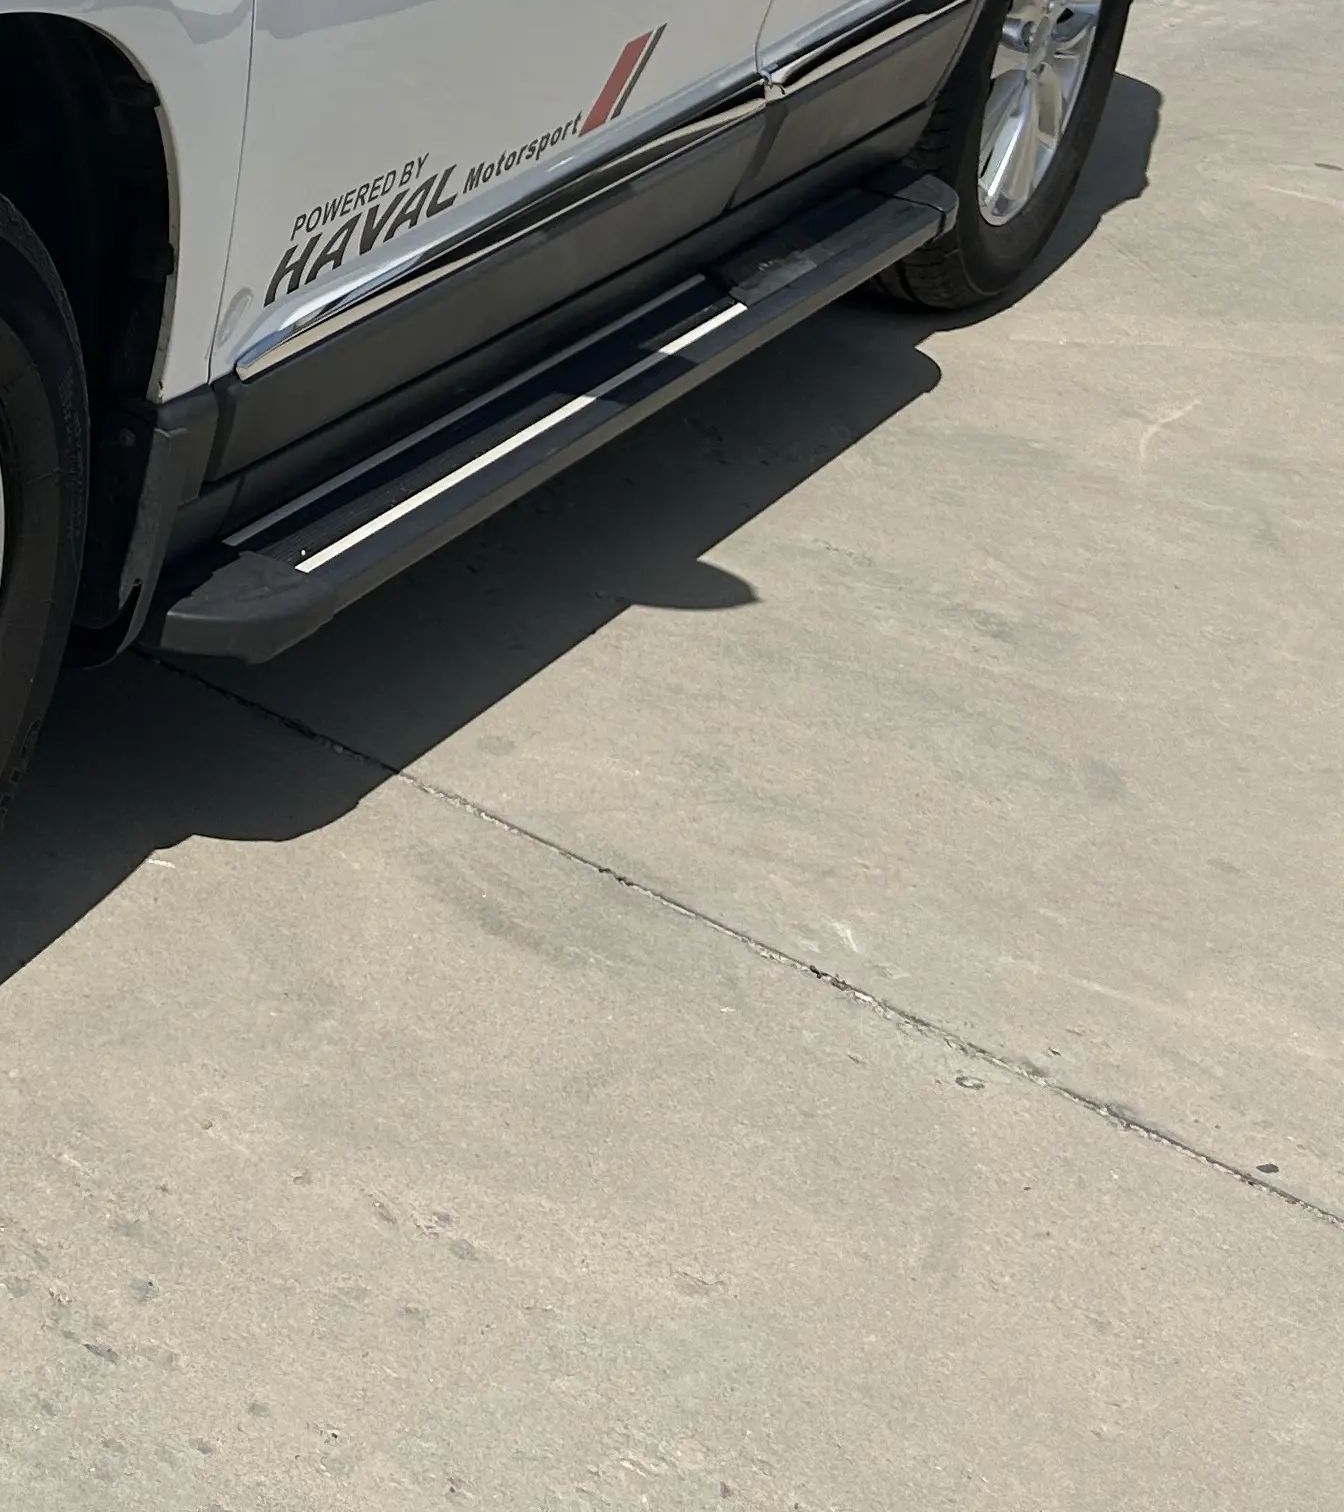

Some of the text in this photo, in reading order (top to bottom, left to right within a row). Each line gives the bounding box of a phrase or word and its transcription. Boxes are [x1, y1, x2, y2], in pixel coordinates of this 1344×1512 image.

[264, 112, 582, 307] HAVAL Motorsport
[290, 153, 429, 241] POWERED BY
